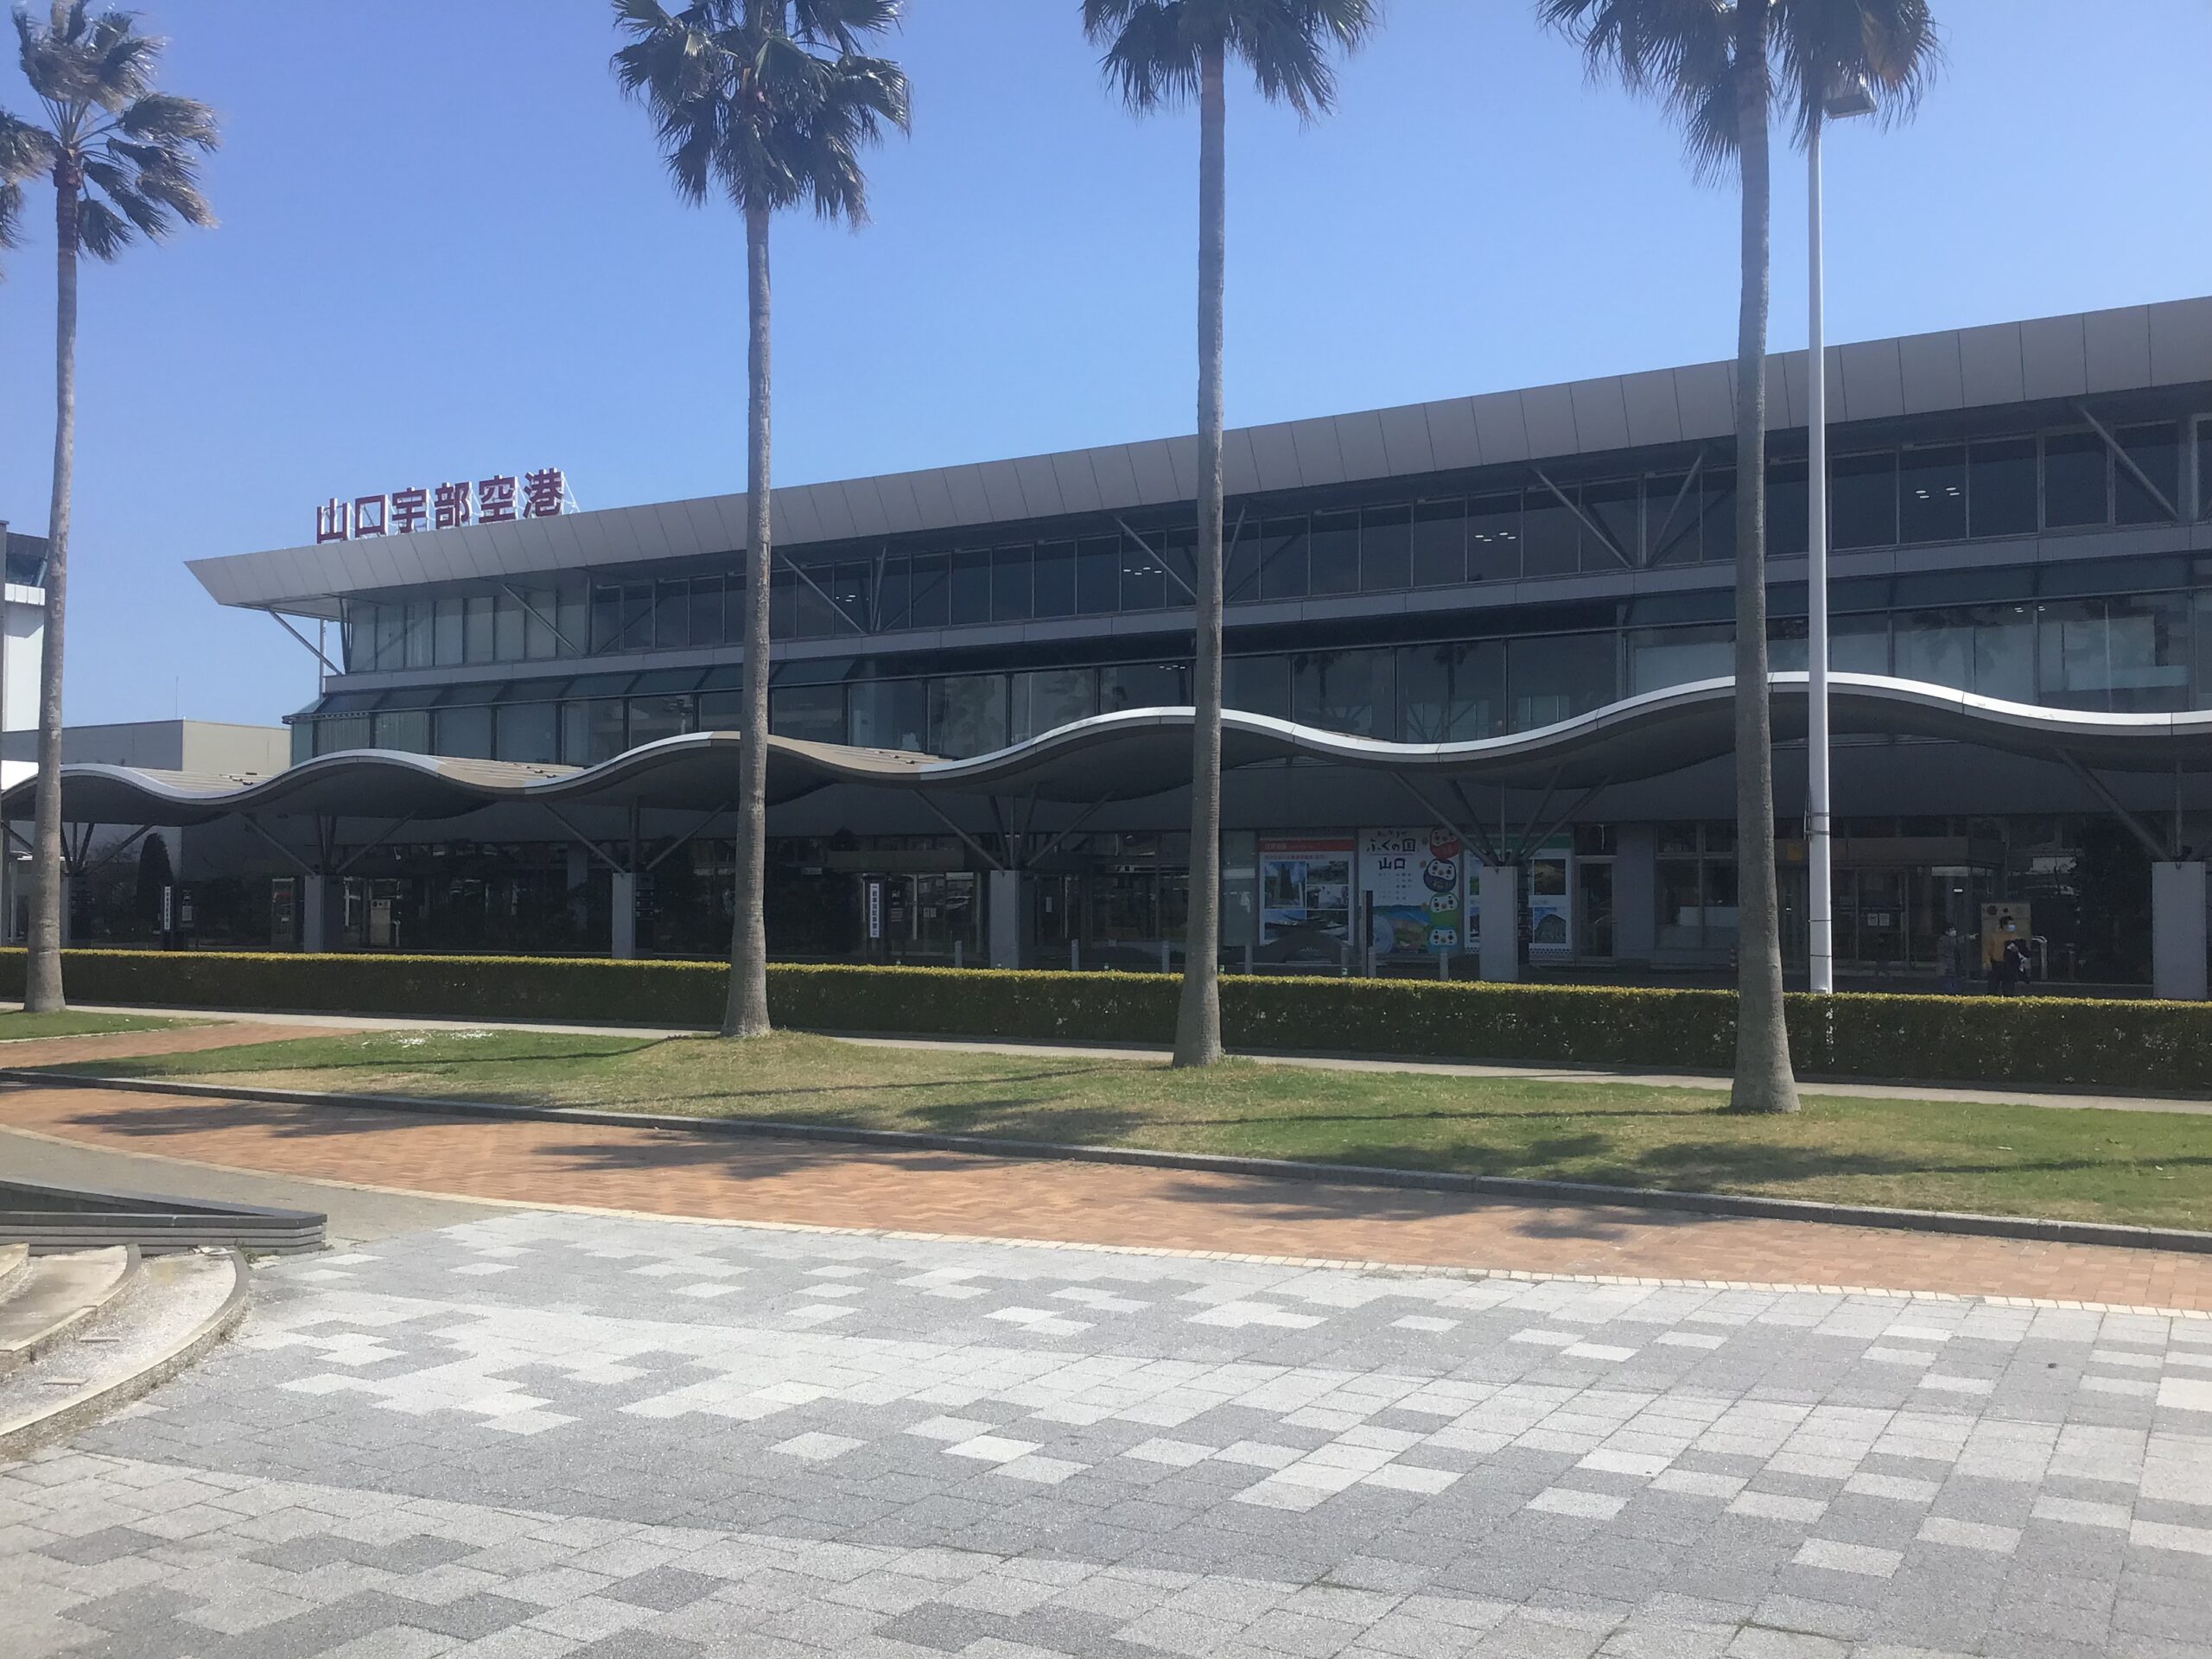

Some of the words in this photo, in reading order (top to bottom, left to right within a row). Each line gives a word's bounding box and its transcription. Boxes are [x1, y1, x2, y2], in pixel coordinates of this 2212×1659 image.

[316, 467, 563, 543] 山口宇部空港
[1378, 857, 1407, 871] 山口
